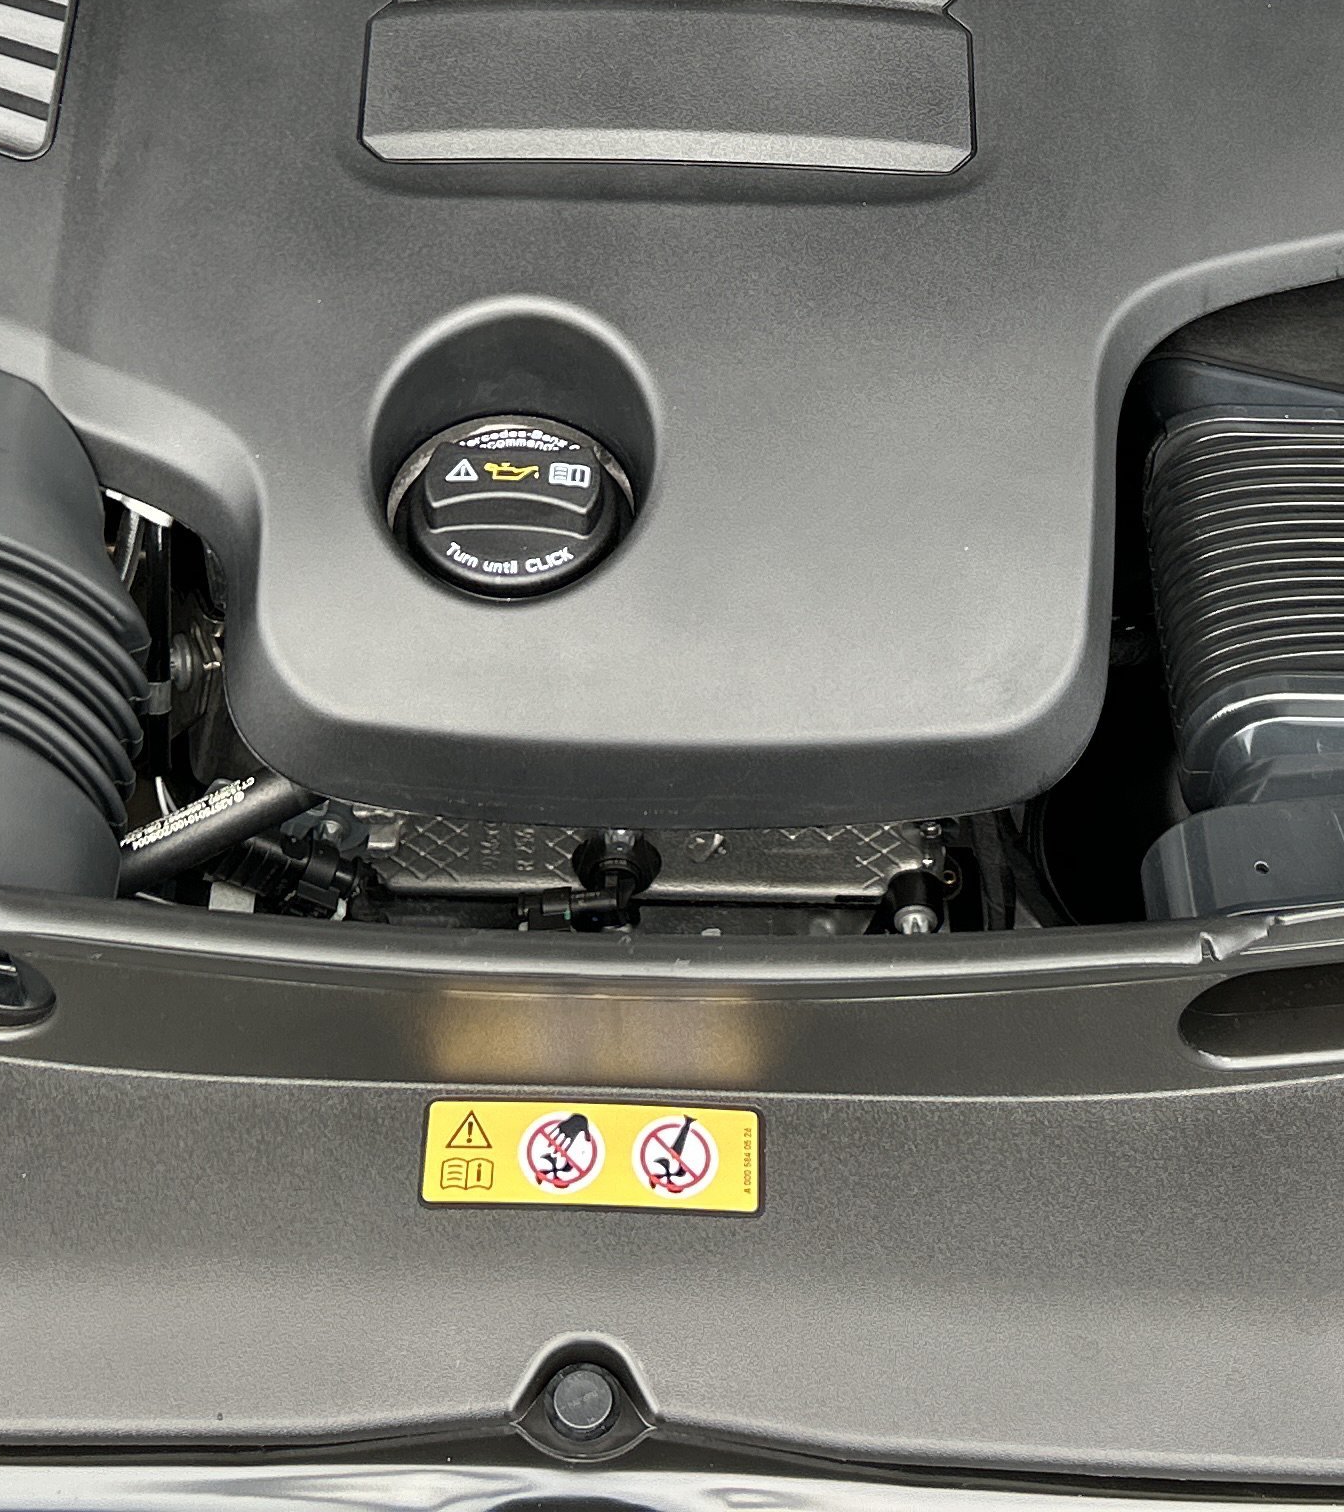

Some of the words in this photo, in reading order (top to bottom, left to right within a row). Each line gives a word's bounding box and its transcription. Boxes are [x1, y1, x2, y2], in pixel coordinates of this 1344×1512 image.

[446, 542, 478, 568] Turn
[482, 560, 518, 574] until
[525, 546, 575, 573] CLICK
